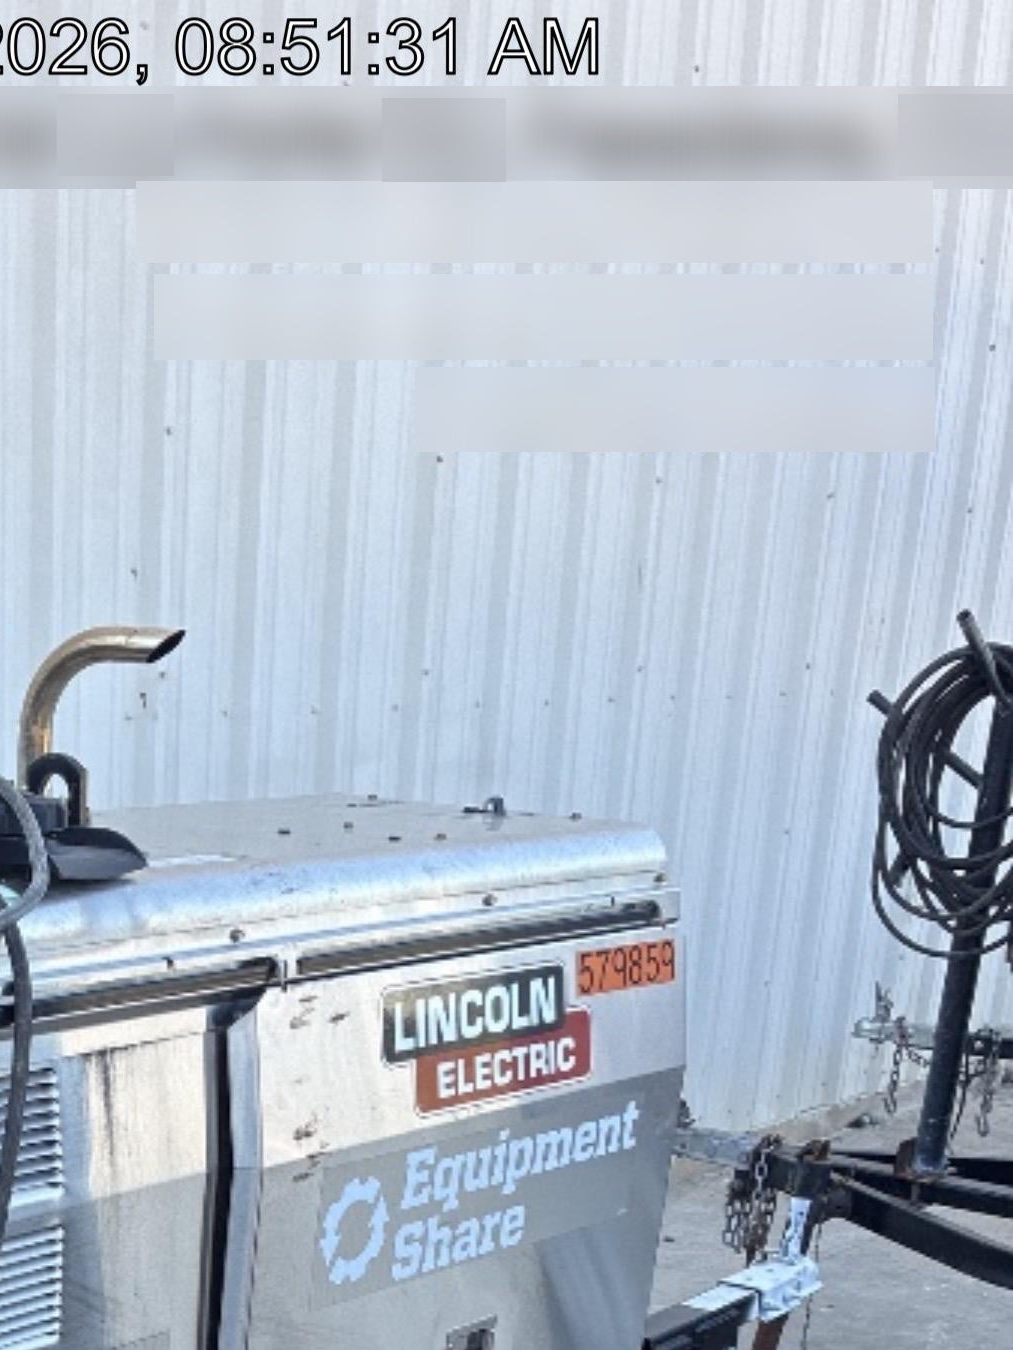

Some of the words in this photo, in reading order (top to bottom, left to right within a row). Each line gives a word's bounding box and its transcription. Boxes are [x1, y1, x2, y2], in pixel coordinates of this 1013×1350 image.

[578, 941, 674, 993] 579859
[393, 975, 557, 1053] LINCOLN
[436, 1037, 576, 1098] ELECTRIC
[400, 1100, 641, 1211] Equipment
[391, 1205, 526, 1281] Share
